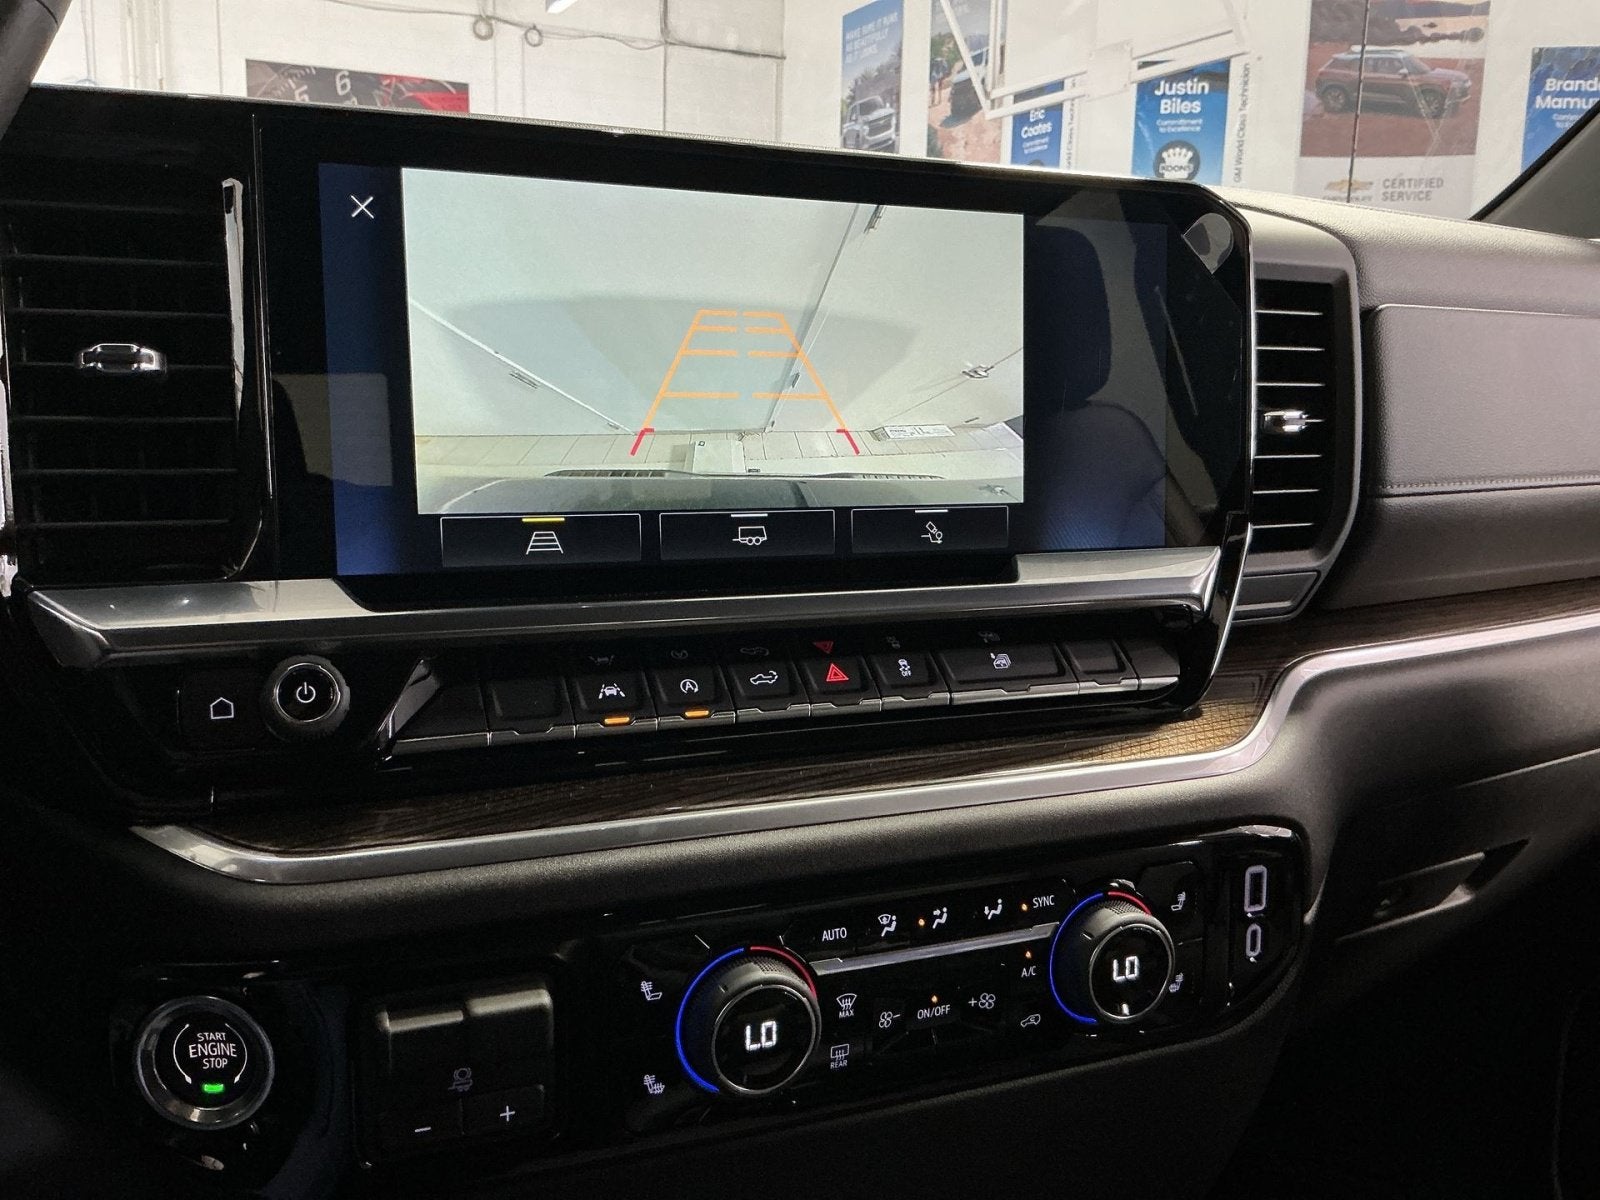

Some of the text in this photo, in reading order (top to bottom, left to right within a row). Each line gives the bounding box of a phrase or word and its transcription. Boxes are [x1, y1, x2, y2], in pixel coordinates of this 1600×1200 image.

[335, 70, 352, 96] 6
[1154, 77, 1210, 96] Justin
[1544, 77, 1600, 92] Brand
[1159, 97, 1202, 115] Biles
[1029, 108, 1046, 122] Eric
[1233, 62, 1250, 183] GM World Class Technician
[1020, 122, 1053, 139] Coates
[1382, 177, 1444, 189] CERTIFIED
[1381, 190, 1432, 202] SERVICE
[1032, 895, 1055, 909] SYNC
[822, 927, 847, 942] AUTO
[1020, 965, 1037, 979] A/C
[1112, 955, 1139, 982] LO
[838, 1009, 854, 1018] MAX
[916, 1004, 951, 1019] ON/OFF
[196, 1032, 227, 1042] START
[743, 1020, 777, 1052] LO
[188, 1042, 238, 1059] ENGINE
[202, 1057, 229, 1070] STOP
[829, 1059, 848, 1069] REAR
